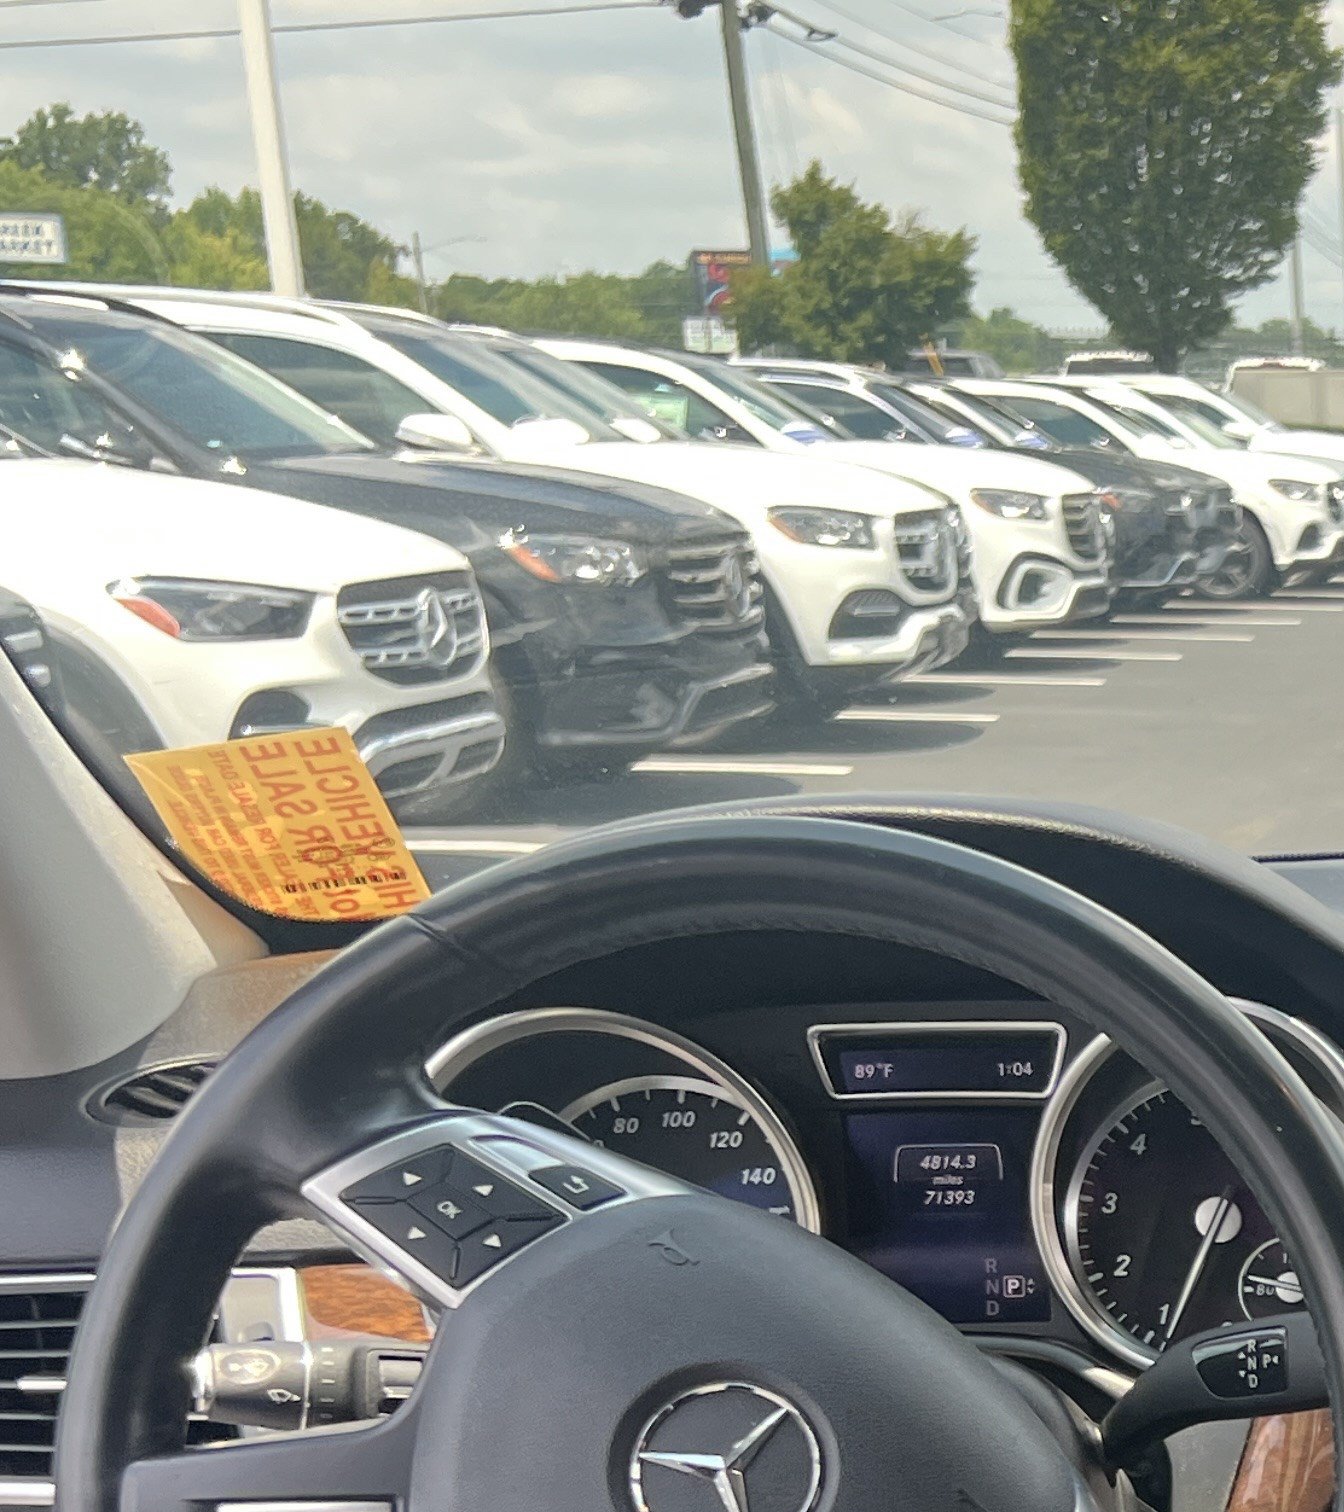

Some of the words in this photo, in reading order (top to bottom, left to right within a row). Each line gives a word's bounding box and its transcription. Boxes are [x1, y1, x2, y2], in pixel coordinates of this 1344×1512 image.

[997, 1062, 1034, 1077] 1:04
[612, 1117, 640, 1134] 80
[661, 1111, 696, 1128] 100
[709, 1131, 743, 1148] 120
[1129, 1134, 1148, 1156] 4
[919, 1154, 977, 1170] 4814.3
[741, 1167, 776, 1185] 140
[931, 1174, 964, 1186] miles
[924, 1190, 976, 1205] 71393
[1100, 1192, 1119, 1215] 3
[435, 1198, 463, 1218] OK
[985, 1257, 998, 1274] R
[1113, 1254, 1132, 1278] 2
[986, 1279, 999, 1295] N
[1006, 1278, 1020, 1295] P
[986, 1300, 1000, 1316] D
[1159, 1302, 1170, 1325] 1
[1247, 1339, 1257, 1352] R
[1247, 1355, 1258, 1370] N
[1262, 1353, 1272, 1368] P
[1248, 1374, 1258, 1388] D
